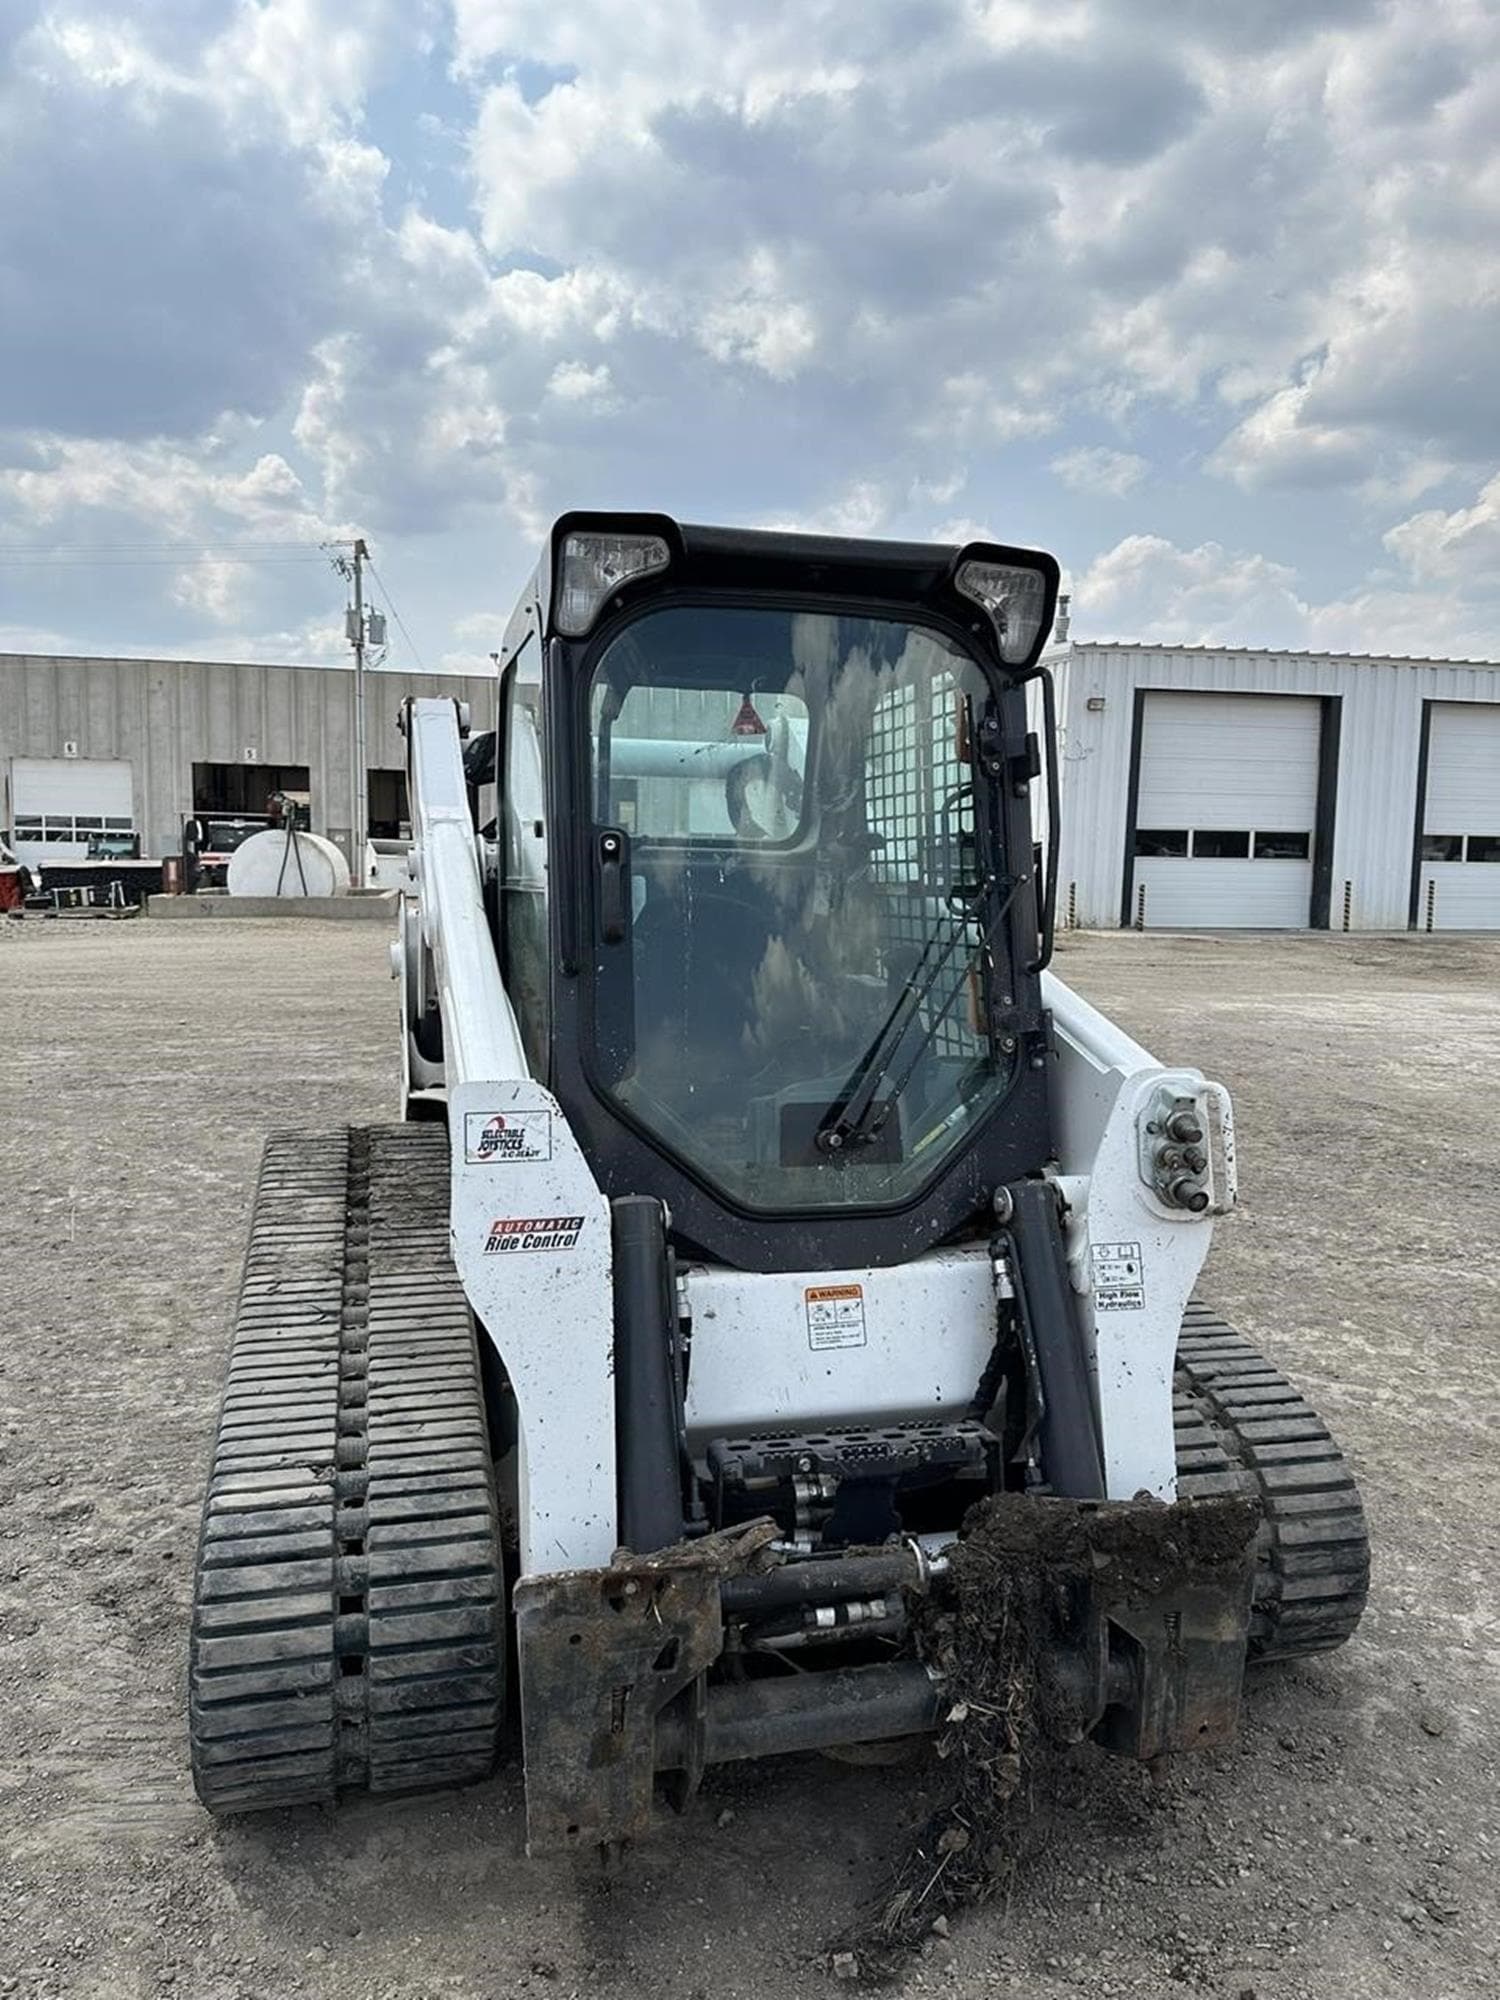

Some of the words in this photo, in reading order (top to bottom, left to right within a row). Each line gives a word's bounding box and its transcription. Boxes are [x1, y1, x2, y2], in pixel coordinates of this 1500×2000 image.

[477, 1138, 525, 1152] JOYSTICKS
[494, 1219, 580, 1233] AUTOMATIC
[484, 1235, 520, 1252] Ride
[521, 1231, 580, 1249] Control
[819, 1288, 858, 1297] WARNING
[1099, 1291, 1118, 1300] High
[1120, 1290, 1139, 1298] Flow
[1098, 1300, 1142, 1309] Hydraulics
